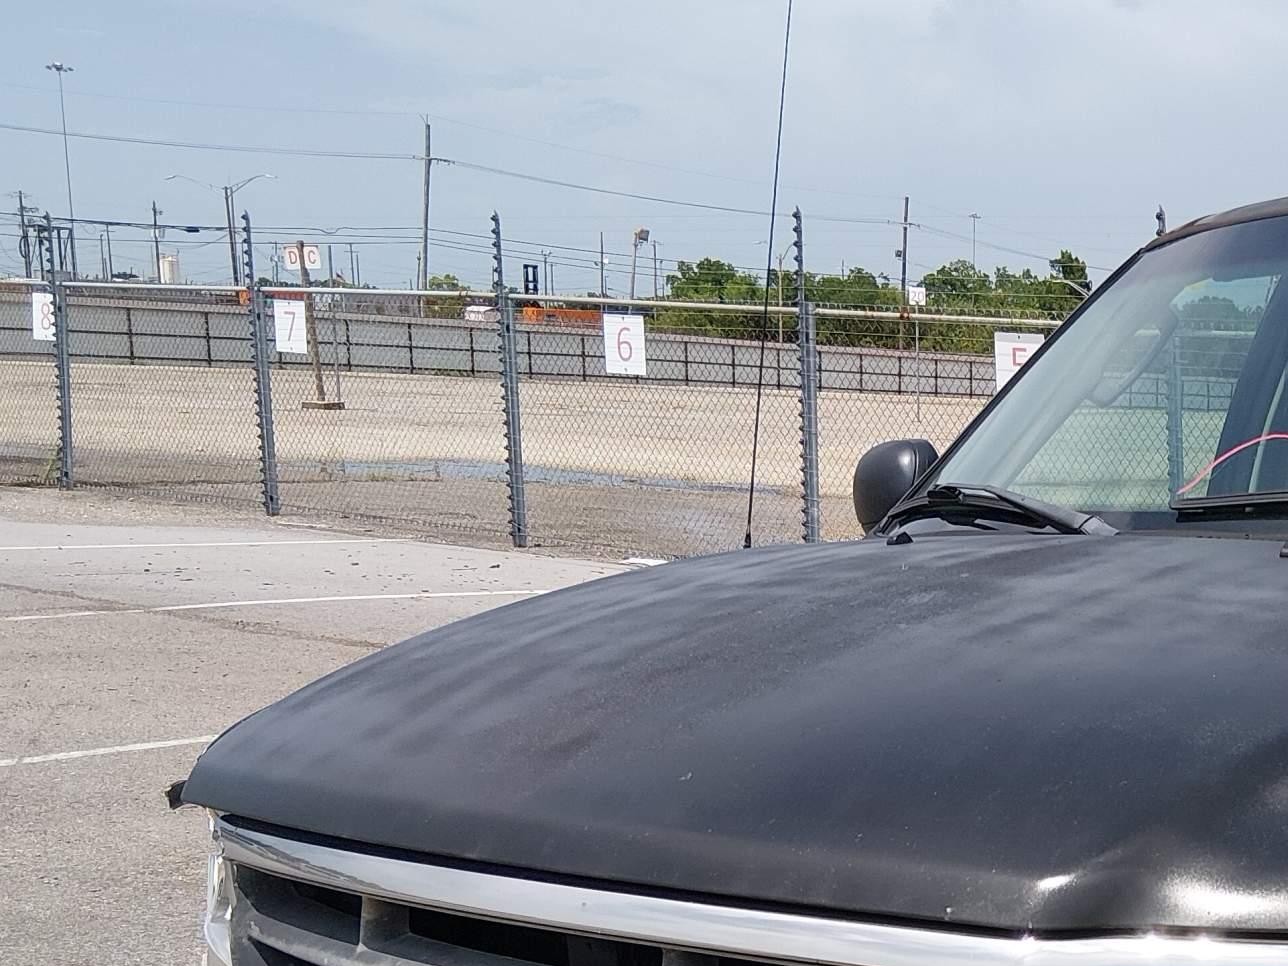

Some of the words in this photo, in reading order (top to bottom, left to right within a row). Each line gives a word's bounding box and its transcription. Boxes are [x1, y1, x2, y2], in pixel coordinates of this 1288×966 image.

[287, 249, 298, 265] D
[307, 249, 317, 265] C
[40, 301, 51, 330] 8
[282, 310, 297, 342] 7
[617, 326, 633, 362] 6
